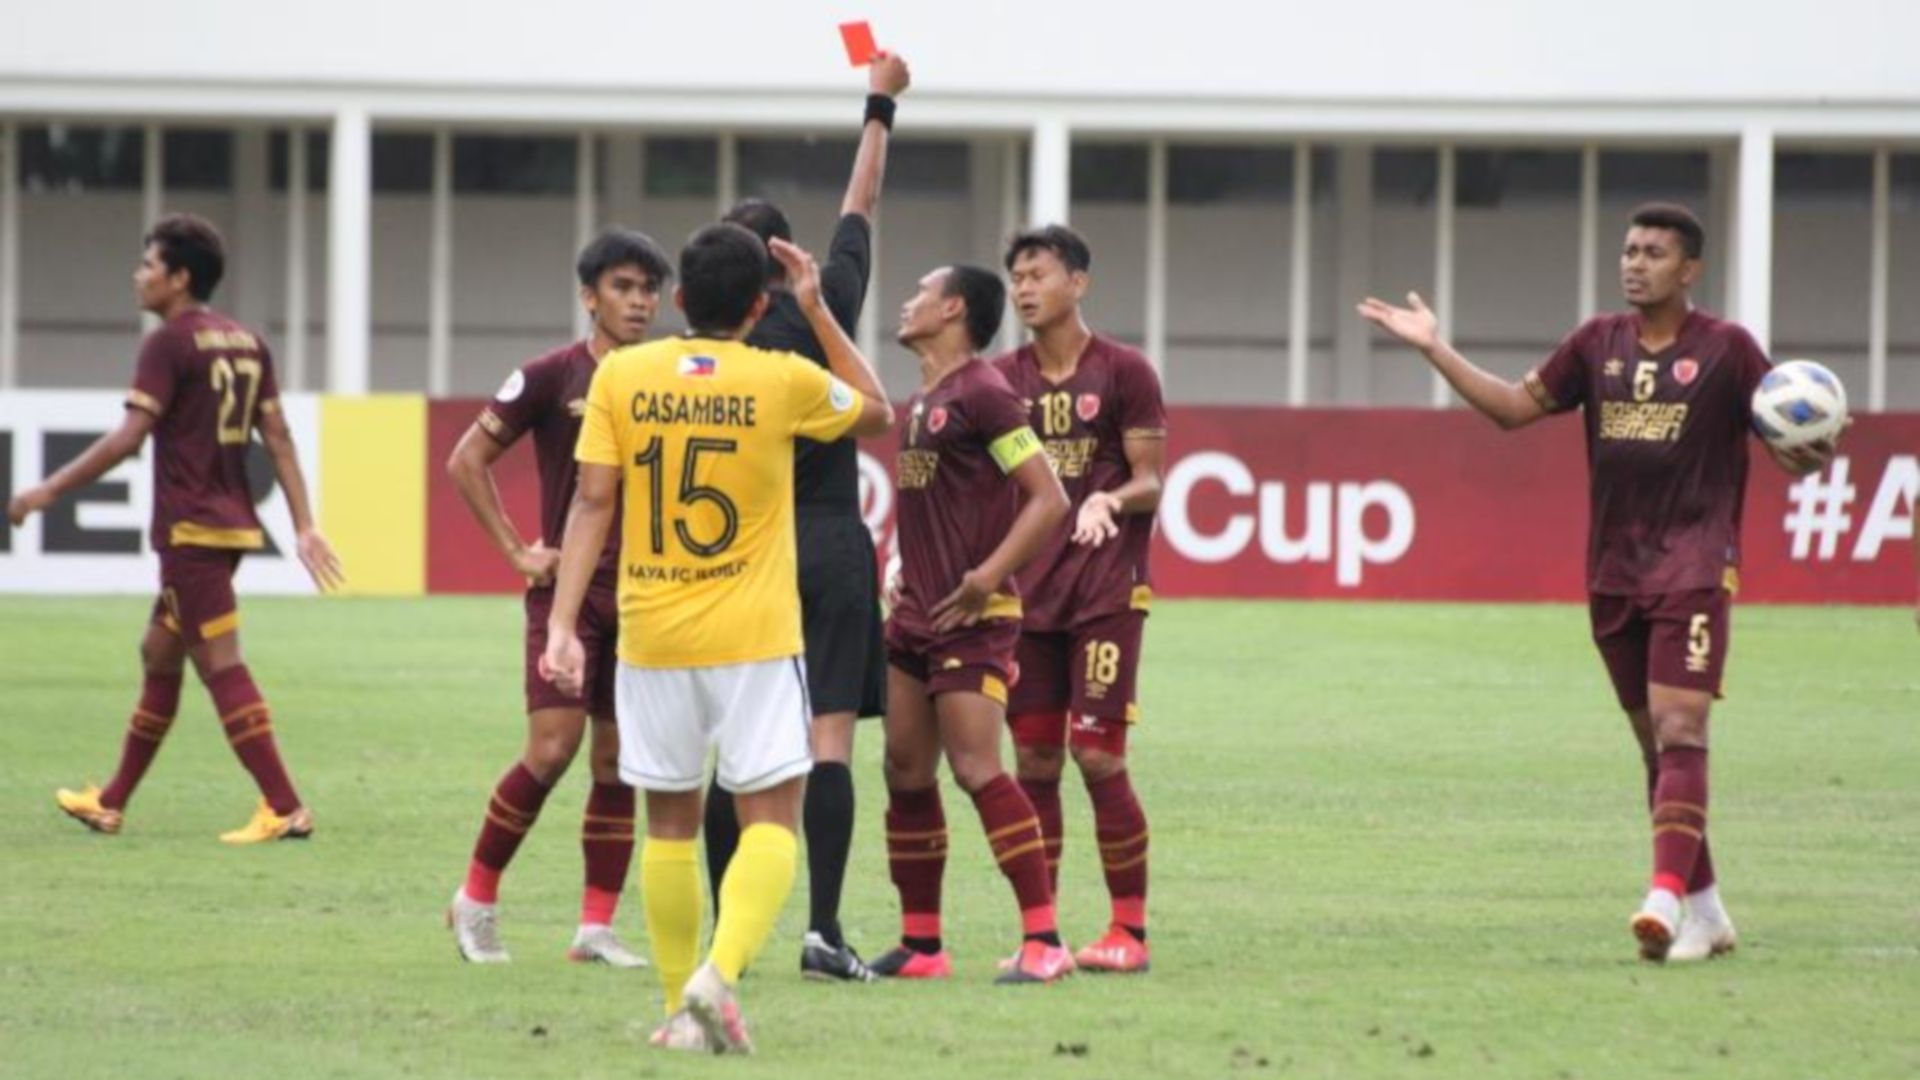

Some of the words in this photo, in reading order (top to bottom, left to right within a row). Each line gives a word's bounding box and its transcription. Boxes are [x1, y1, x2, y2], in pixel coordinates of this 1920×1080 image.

[210, 357, 262, 446] 27
[1633, 360, 1658, 402] 5
[631, 391, 756, 427] CASAMBRE
[1039, 391, 1072, 436] 18
[634, 435, 739, 558] 15
[671, 565, 691, 584] FC
[1687, 613, 1711, 657] 5
[1085, 639, 1120, 685] 18
